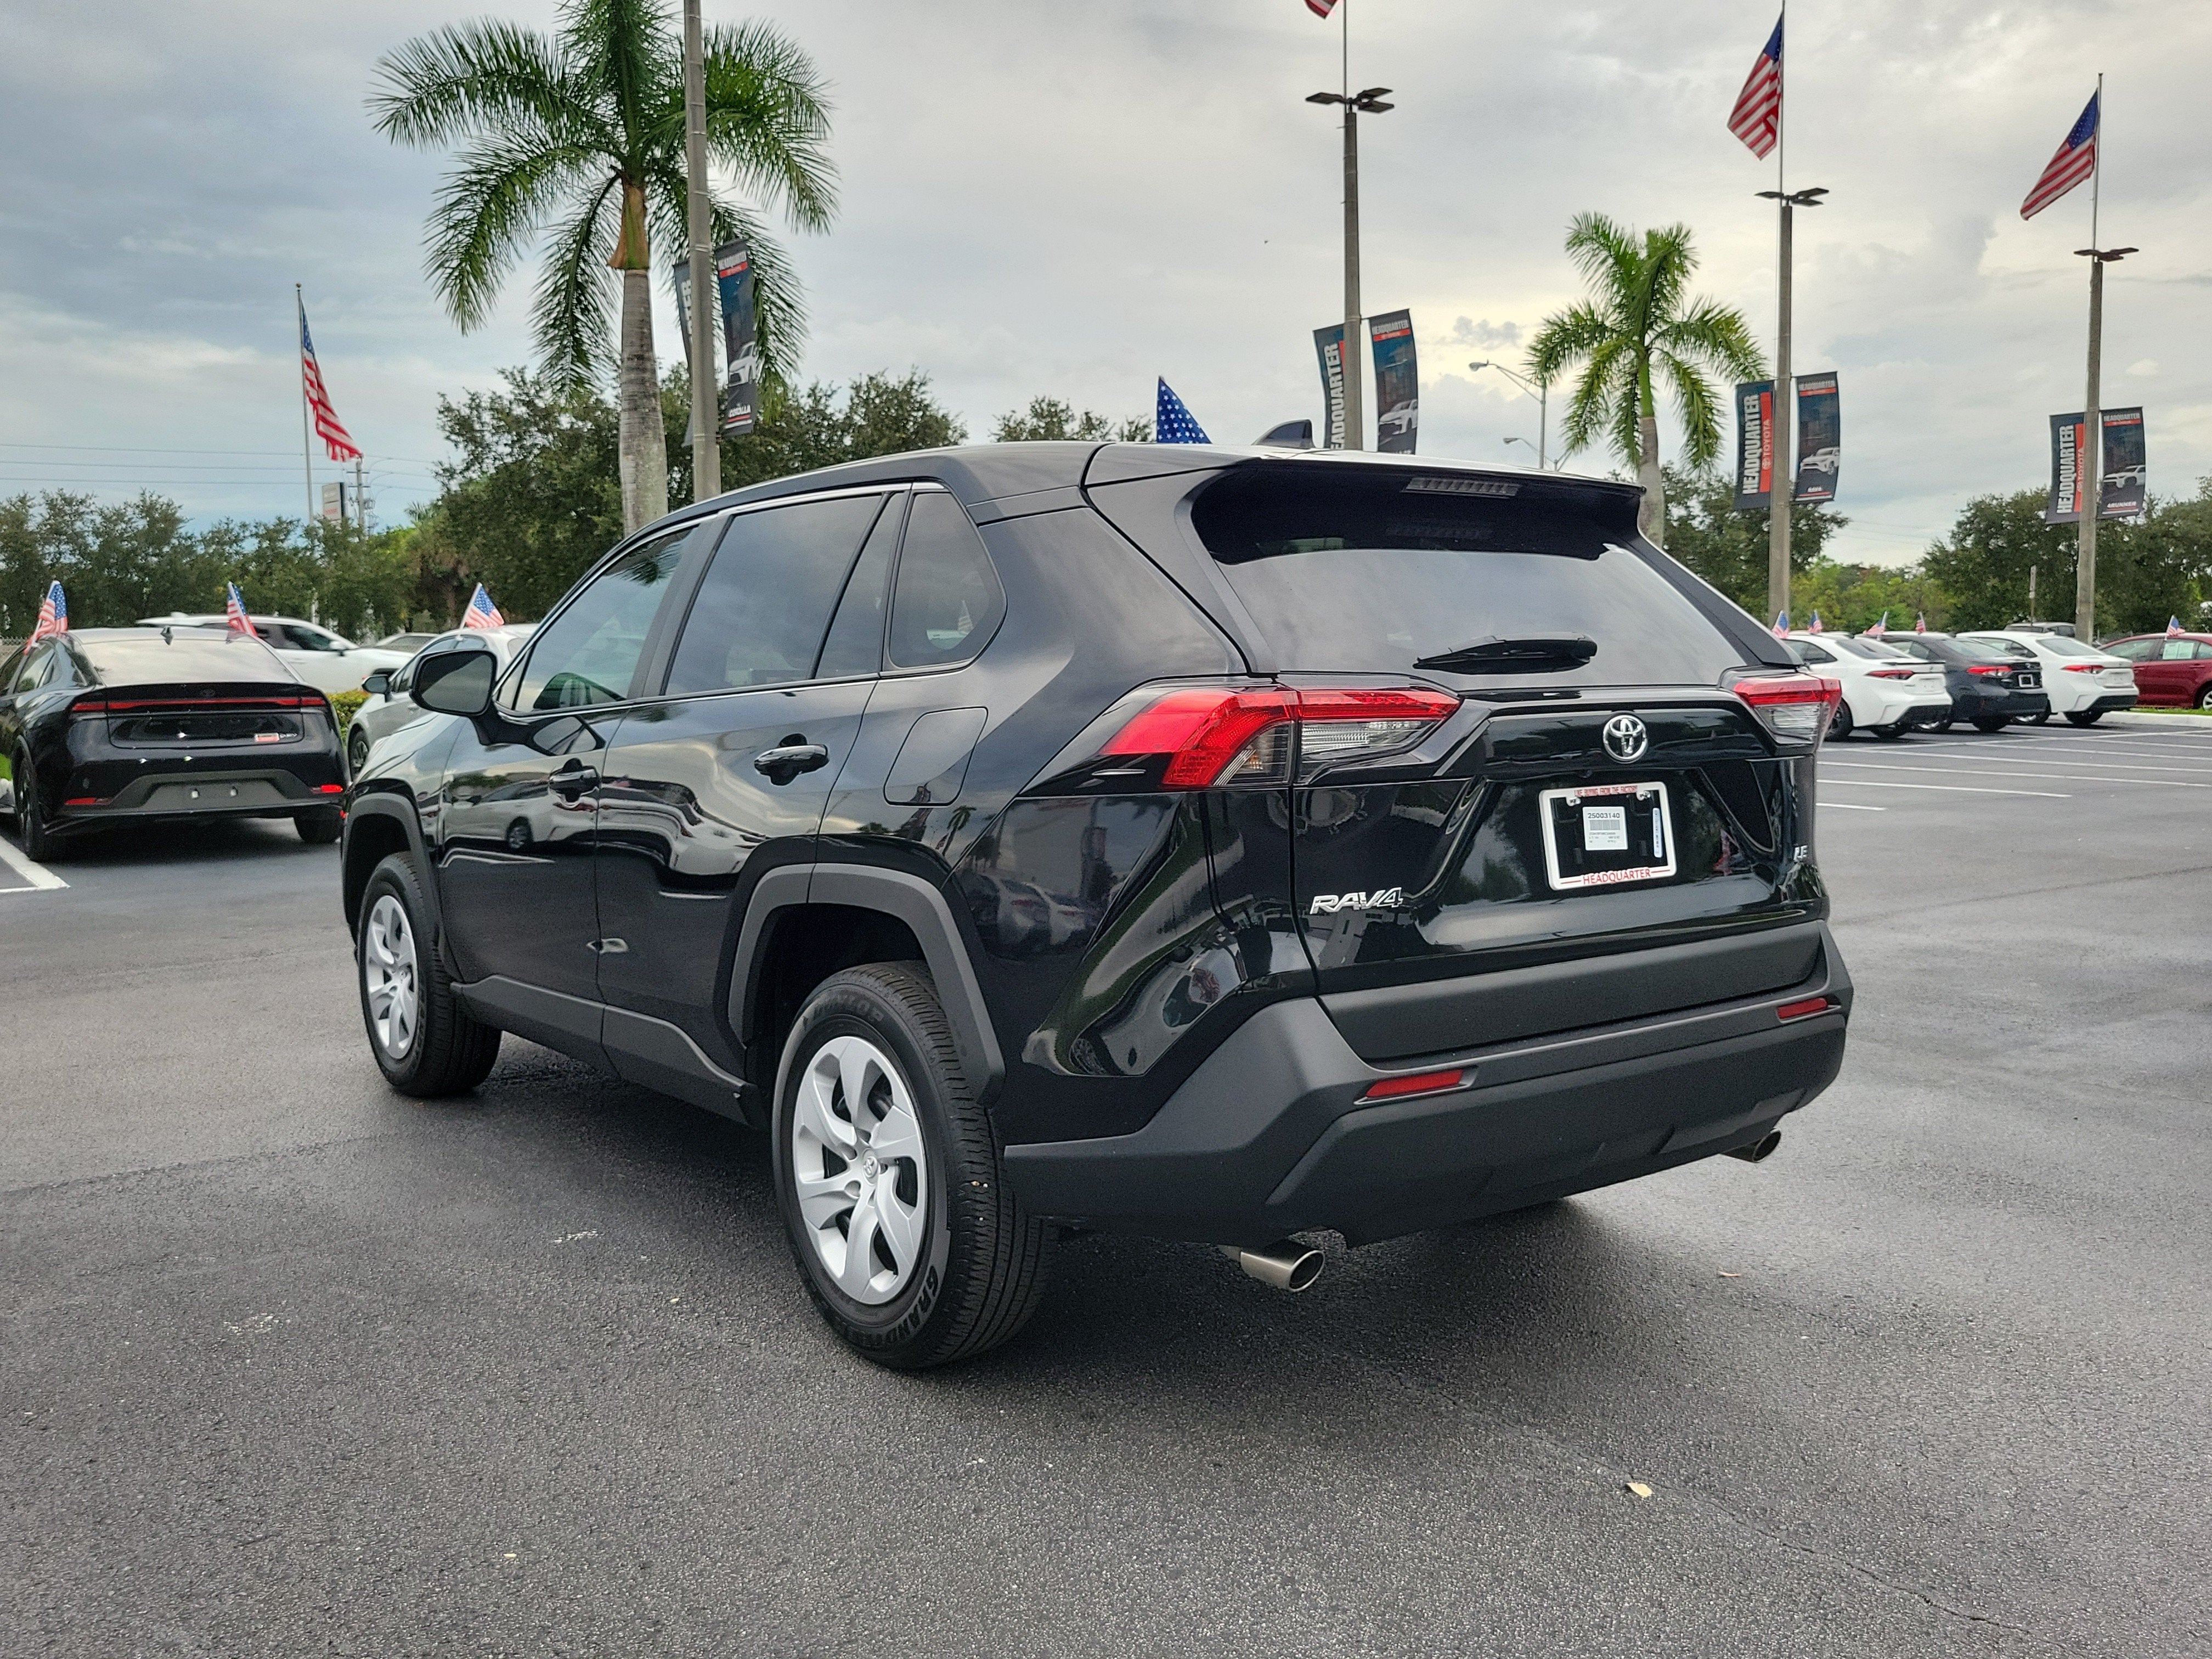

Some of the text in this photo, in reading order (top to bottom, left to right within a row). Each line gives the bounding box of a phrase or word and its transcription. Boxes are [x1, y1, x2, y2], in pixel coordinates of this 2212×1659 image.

[1324, 343, 1345, 449] EADQUARTER
[1742, 394, 1762, 494] HEADQUARTER
[1763, 419, 1771, 456] TOYOTA
[2057, 425, 2076, 514] HEADQUARTER
[1310, 887, 1403, 914] RAV4
[1583, 869, 1651, 884] HEADQUARTER
